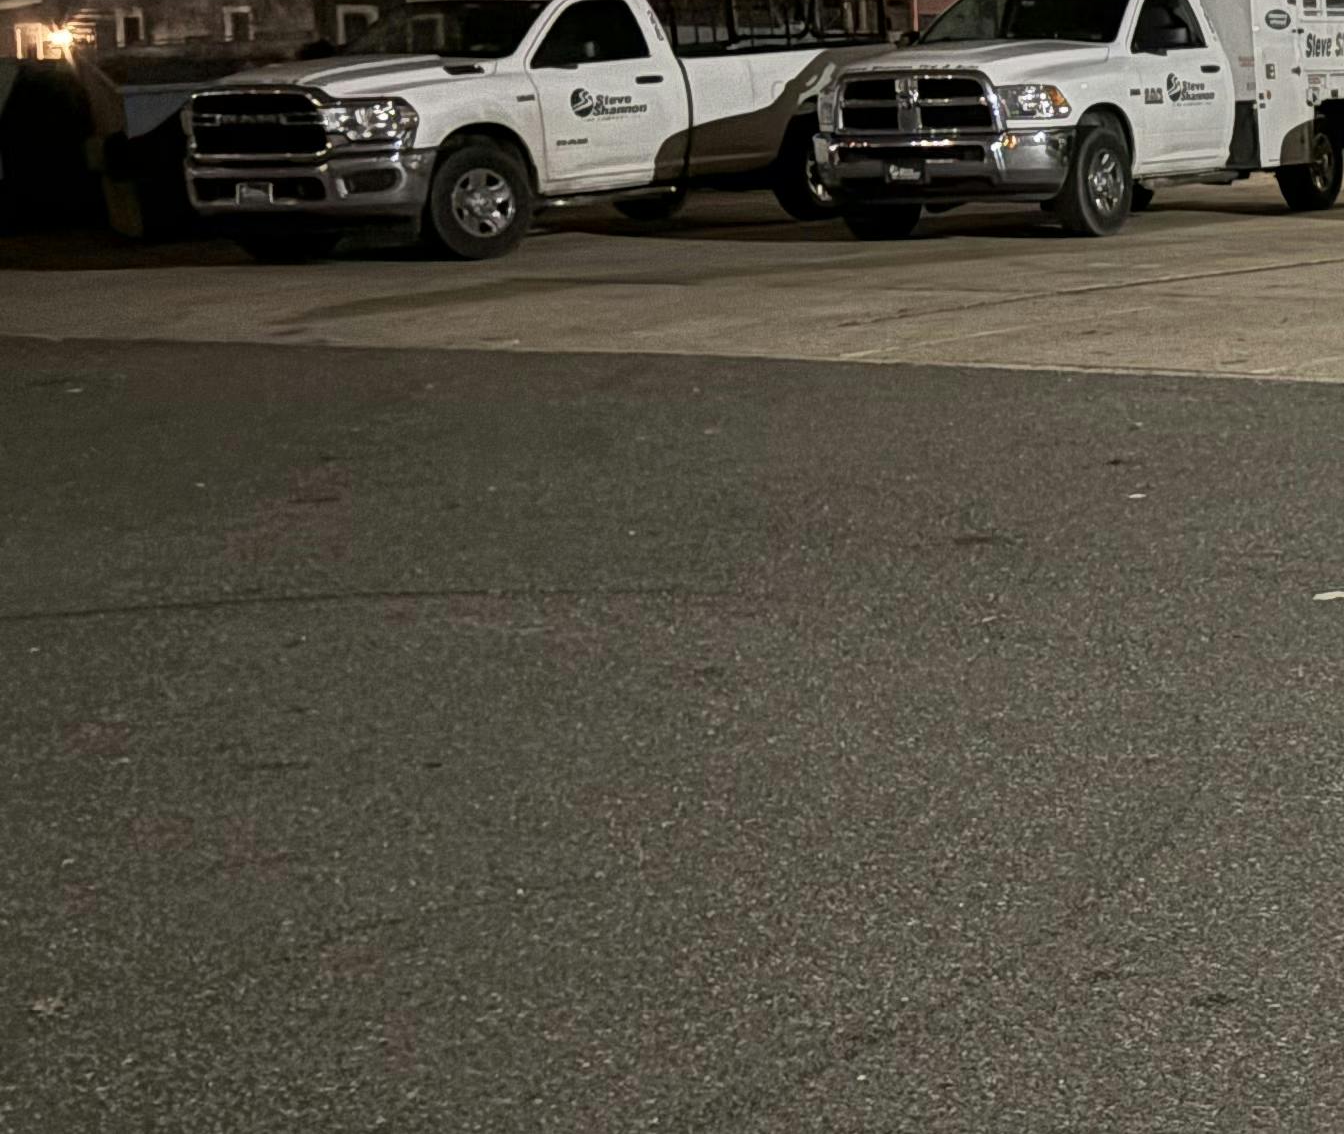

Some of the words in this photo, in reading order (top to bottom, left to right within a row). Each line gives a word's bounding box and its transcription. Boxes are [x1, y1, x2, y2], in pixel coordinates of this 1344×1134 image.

[1306, 32, 1332, 58] Steve
[595, 94, 632, 106] Steve
[592, 104, 648, 116] Shannon
